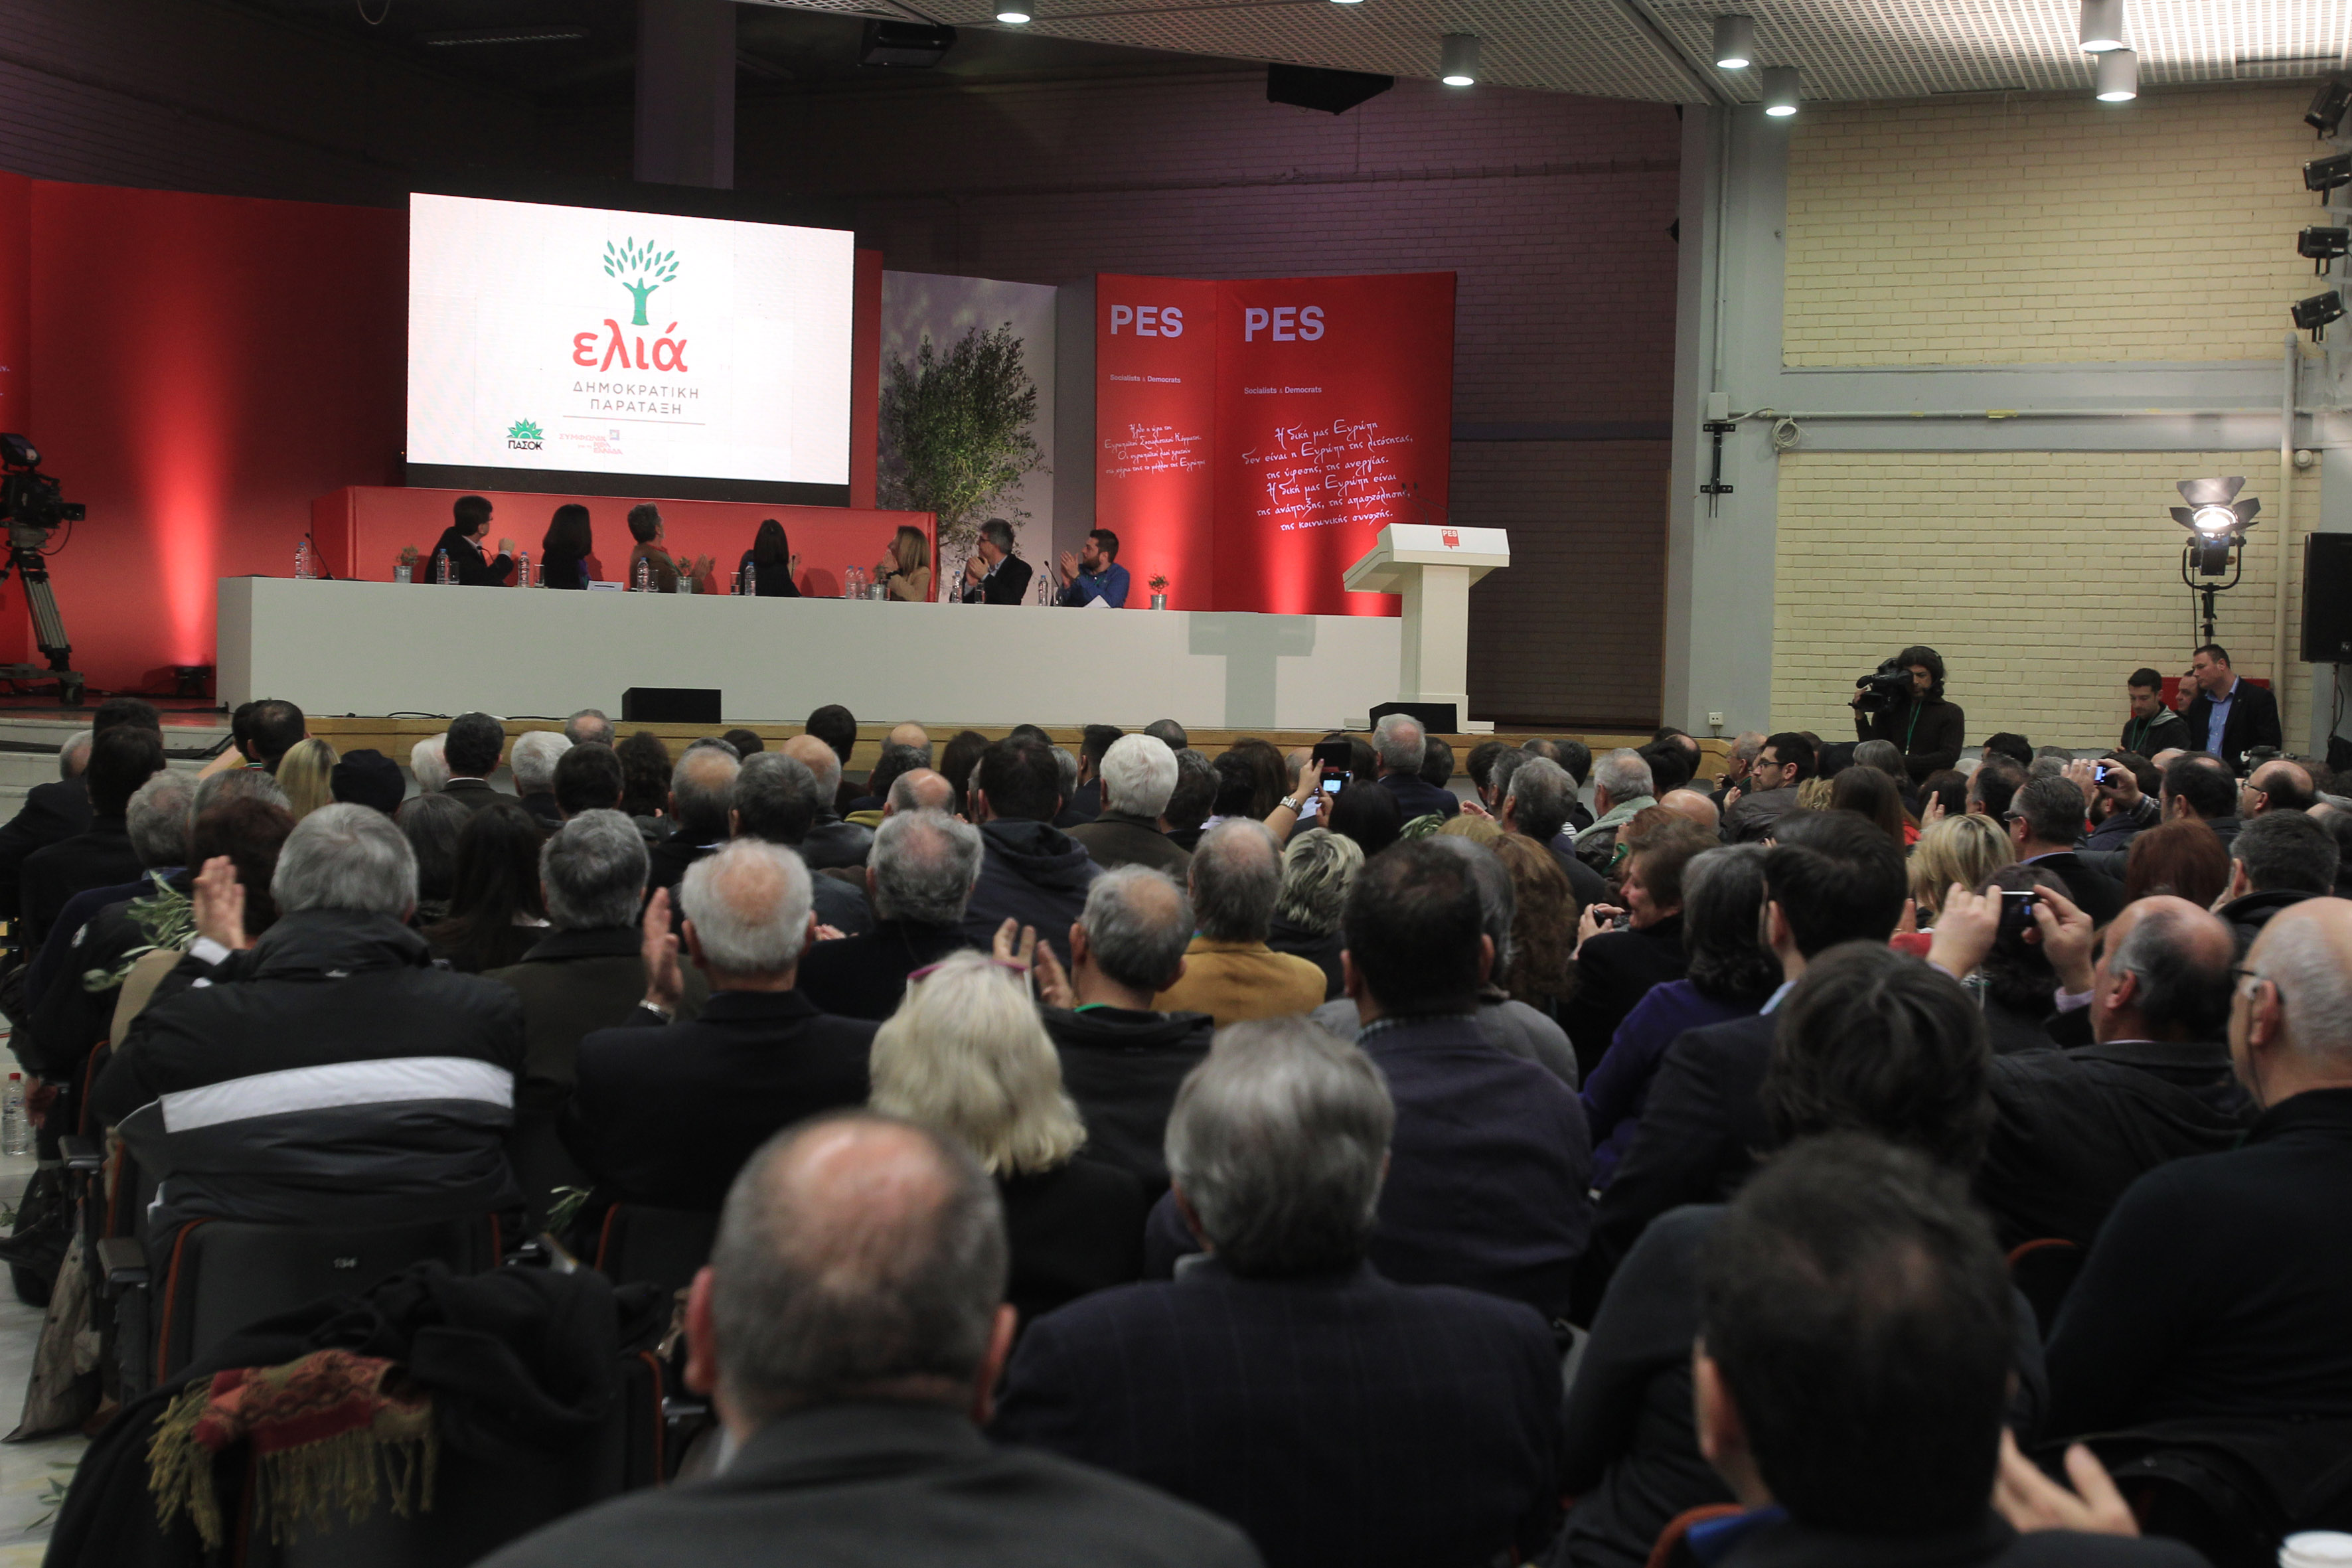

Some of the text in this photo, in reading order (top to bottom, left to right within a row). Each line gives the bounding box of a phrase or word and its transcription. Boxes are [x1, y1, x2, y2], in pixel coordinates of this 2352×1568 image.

[1111, 305, 1183, 338] PES
[1245, 305, 1324, 342] PES
[572, 319, 688, 372] ελιά
[572, 381, 698, 399] ΔΗΜΟΚΡΑΤΙΚΗ
[591, 399, 681, 414] ΠΑΡΑΤΑΞΗ
[1287, 422, 1309, 440] δική
[1313, 428, 1329, 445] μας
[1333, 419, 1378, 441] Ευρώπη
[508, 440, 543, 450] ΠΑΣΟΚ
[1242, 447, 1261, 465] δεν
[1265, 450, 1287, 461] είναι
[1301, 442, 1345, 464] Ευρώπη
[1348, 441, 1364, 449] της
[1266, 471, 1281, 479] της
[1326, 463, 1340, 471] της
[1279, 479, 1300, 495] δική
[1304, 484, 1320, 499] μας
[1324, 475, 1369, 497] Ευρώπη
[1373, 473, 1397, 483] είναι
[1328, 498, 1343, 507] της
[1280, 509, 1393, 531] της κοινωνικής συνοχής.
